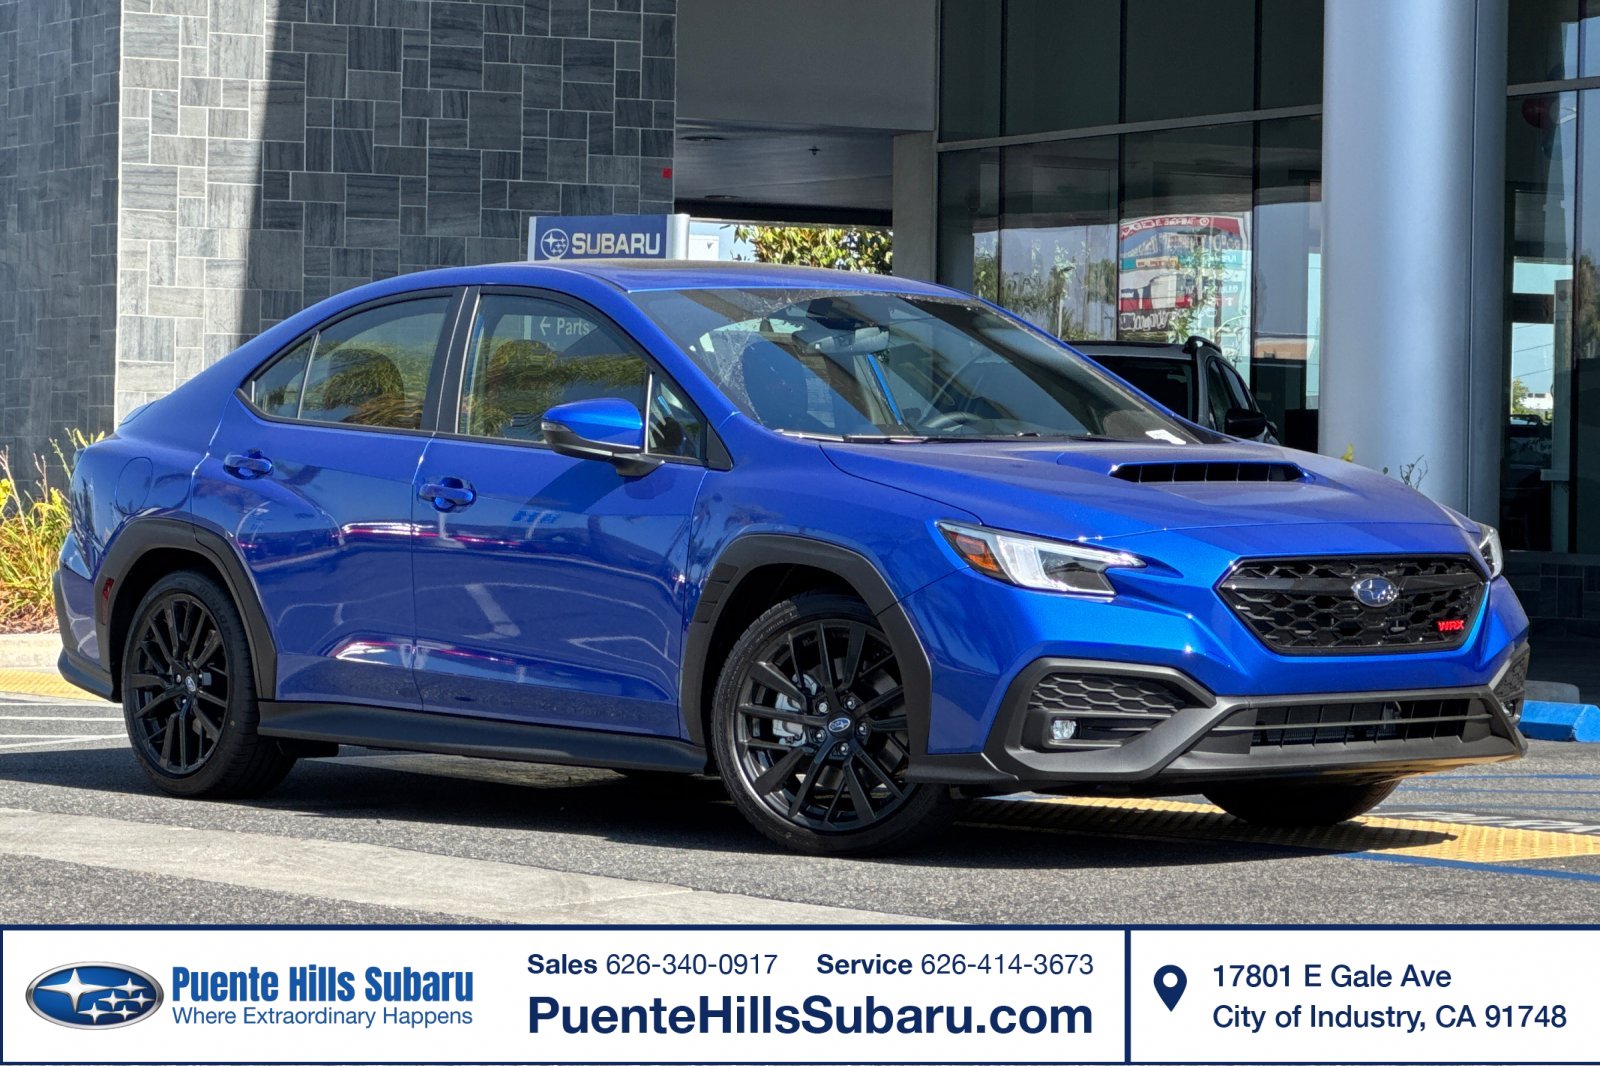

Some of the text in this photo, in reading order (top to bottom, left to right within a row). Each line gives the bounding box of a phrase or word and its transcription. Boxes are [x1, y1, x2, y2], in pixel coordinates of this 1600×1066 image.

[572, 233, 660, 254] SUBARU
[557, 317, 590, 336] Parts
[1437, 620, 1465, 631] WRX
